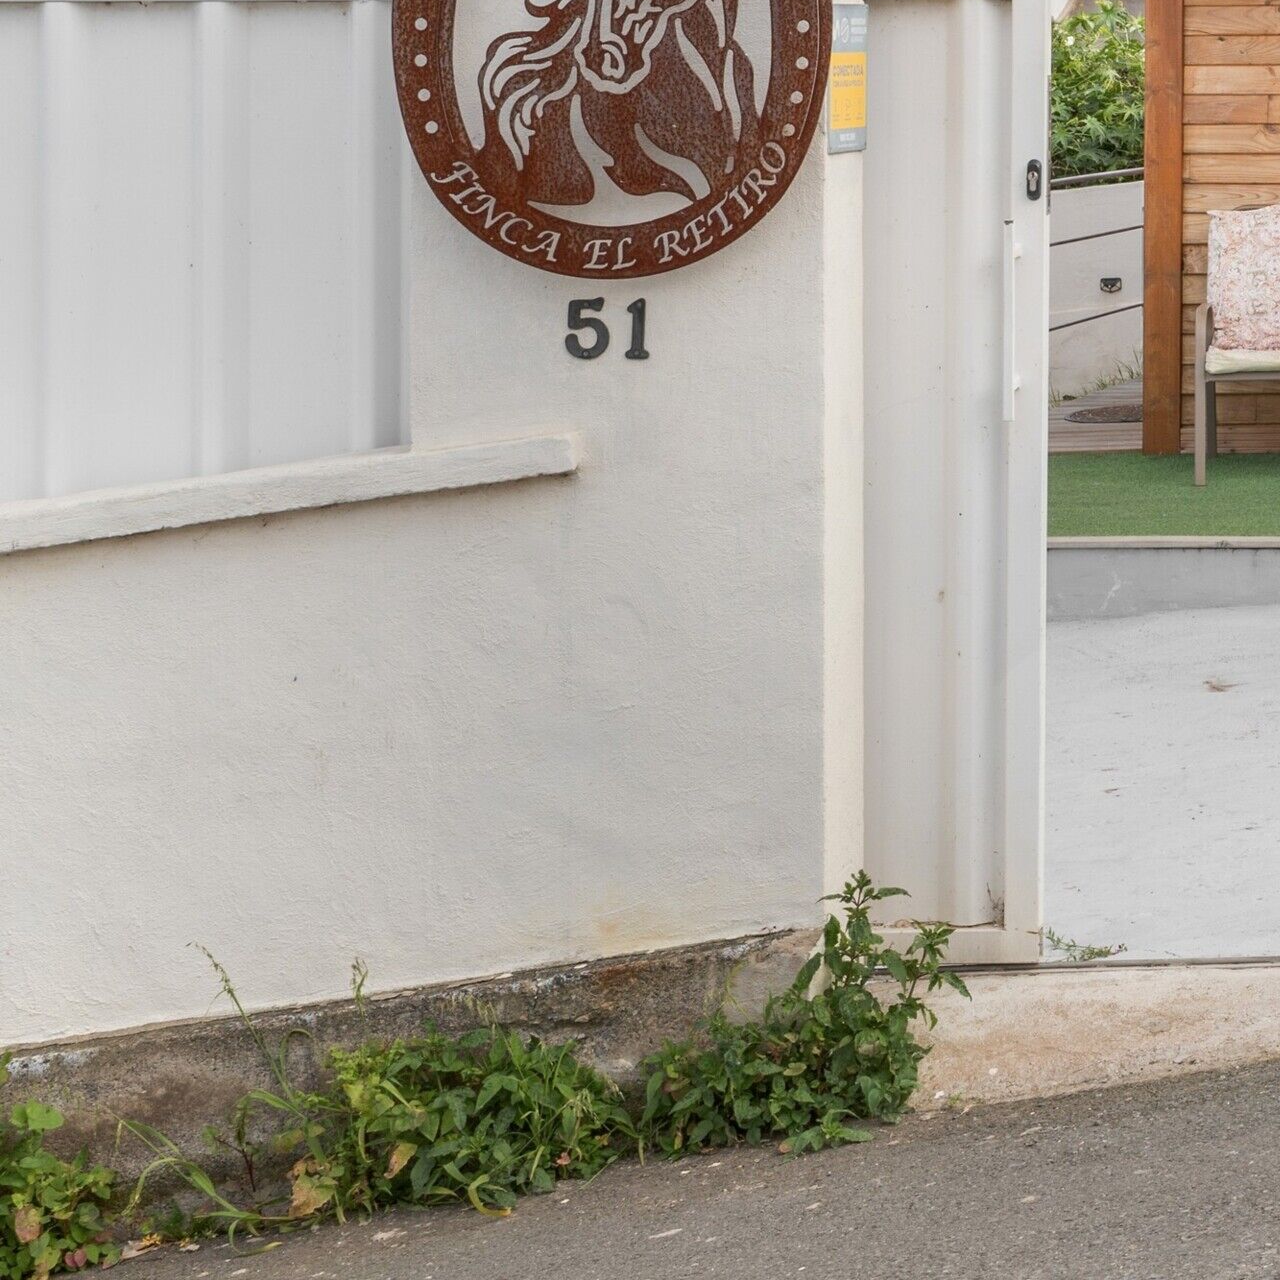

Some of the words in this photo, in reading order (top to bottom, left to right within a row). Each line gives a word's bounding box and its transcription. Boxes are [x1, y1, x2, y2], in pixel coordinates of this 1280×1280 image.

[430, 161, 562, 262] FINCA
[582, 237, 638, 270] EL
[653, 140, 787, 264] RETIRO
[564, 296, 650, 360] 51
